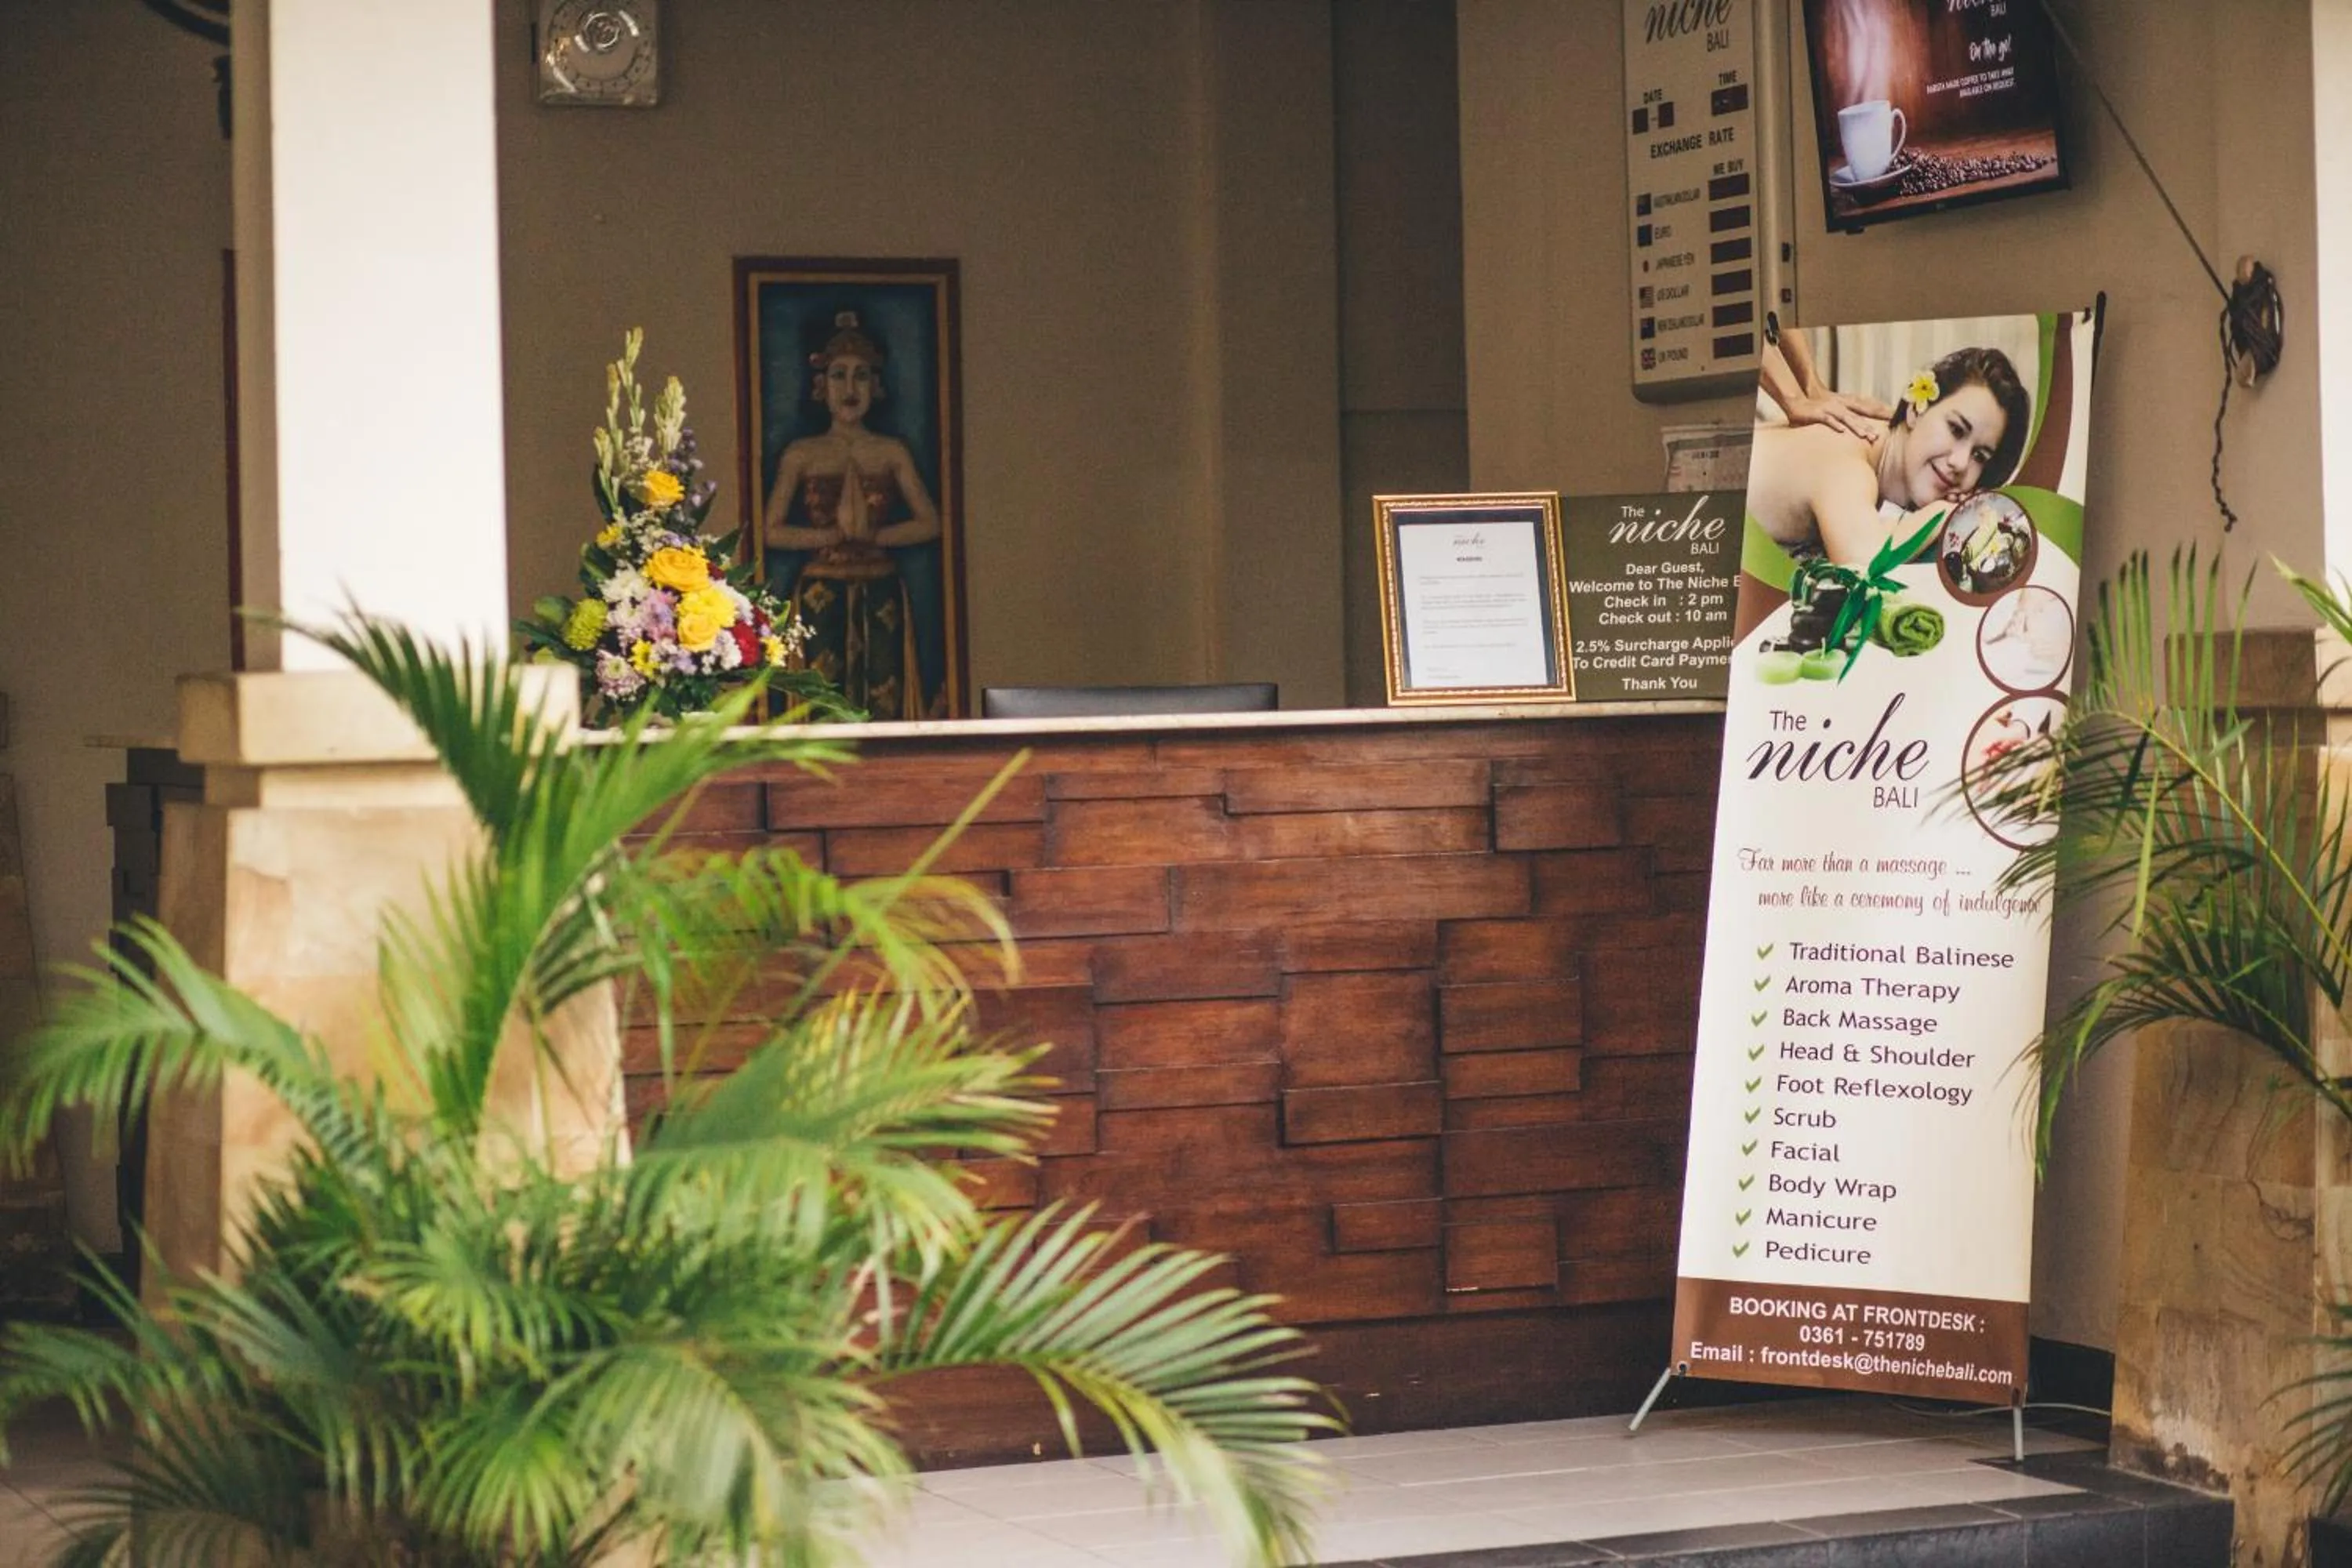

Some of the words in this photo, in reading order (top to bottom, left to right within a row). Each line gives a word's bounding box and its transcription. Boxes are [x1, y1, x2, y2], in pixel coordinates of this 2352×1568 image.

[1707, 29, 1730, 52] BALI
[1719, 70, 1737, 85] TIME
[1643, 89, 1663, 104] DATE
[1650, 134, 1703, 158] EXCHANGE
[1708, 126, 1735, 146] RATE
[1609, 495, 1726, 543] niche
[1621, 506, 1645, 518] The
[1691, 543, 1719, 555] BALI
[1626, 563, 1657, 575] Dear
[1661, 561, 1705, 575] Guest,
[1569, 579, 1635, 593] Welcome
[1638, 579, 1652, 591] to
[1657, 577, 1684, 590] The
[1688, 575, 1729, 590] Niche
[1604, 594, 1649, 608] Check
[1653, 595, 1667, 608] in
[1688, 593, 1697, 605] 2
[1701, 594, 1724, 608] pm
[1599, 611, 1644, 626] Check
[1647, 612, 1671, 624] out
[1685, 609, 1701, 622] 10
[1705, 611, 1728, 622] am
[1576, 639, 1610, 653] 2.5%
[1614, 637, 1690, 655] Surcharge
[1693, 636, 1734, 652] Appli
[1573, 656, 1589, 669] To
[1592, 655, 1637, 669] Credit
[1640, 653, 1675, 667] Card
[1622, 677, 1665, 691] Thank
[1669, 677, 1698, 690] You
[1769, 710, 1807, 731] The
[1746, 692, 1929, 782] niche
[1872, 786, 1918, 809] BALI
[1737, 848, 1775, 872] Far
[1781, 856, 1816, 873] more
[1822, 851, 1853, 873] than
[1859, 858, 1869, 873] a
[1876, 858, 1948, 880] massage
[1758, 890, 1794, 908] more
[1800, 885, 1830, 908] like
[1834, 892, 1843, 908] a
[1850, 892, 1924, 916] ceremony
[1933, 887, 1950, 916] of
[1789, 942, 1905, 964] Traditional
[1916, 946, 2015, 969] Balinese
[1784, 975, 1852, 996] Aroma
[1860, 978, 1961, 1004] Therapy
[1782, 1008, 1831, 1029] Back
[1838, 1011, 1938, 1036] Massage
[1779, 1042, 1834, 1062] Head
[1843, 1044, 1861, 1063] &
[1870, 1045, 1976, 1069] Shoulder
[1777, 1075, 1825, 1094] Foot
[1834, 1077, 1973, 1105] Reflexology
[1773, 1108, 1837, 1129] Scrub
[1770, 1142, 1840, 1163] Facial
[1768, 1174, 1826, 1199] Body
[1835, 1178, 1897, 1203] Wrap
[1766, 1208, 1878, 1232] Manicure
[1765, 1241, 1872, 1265] Pedicure
[1730, 1297, 1828, 1319] BOOKING
[1831, 1305, 1858, 1322] AT
[1864, 1305, 1976, 1332] FRONTDESK
[1799, 1325, 1844, 1345] 0361
[1864, 1330, 1926, 1352] 751789
[1690, 1341, 1744, 1363] Email
[1760, 1345, 2013, 1385] frontdesk@thenichebali.com
